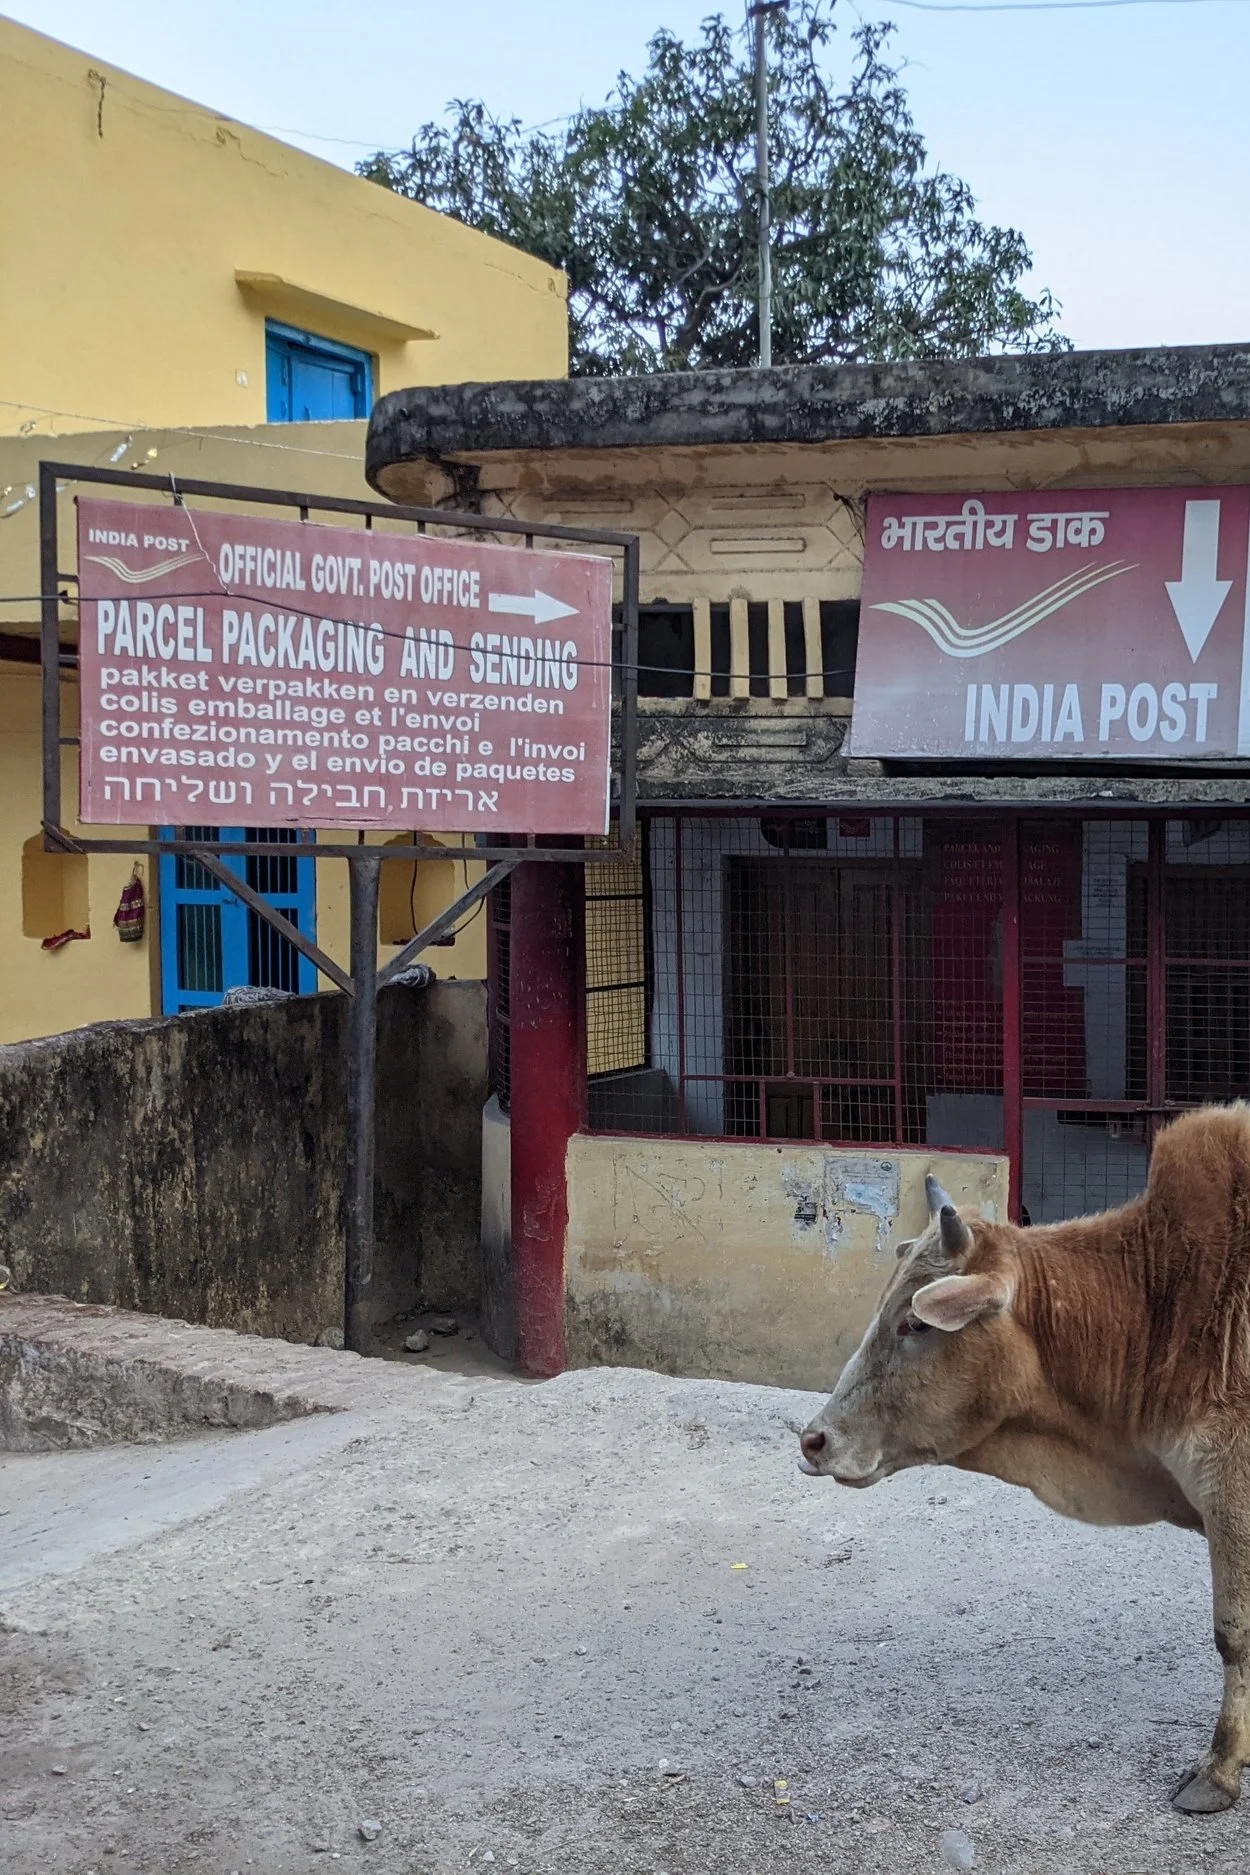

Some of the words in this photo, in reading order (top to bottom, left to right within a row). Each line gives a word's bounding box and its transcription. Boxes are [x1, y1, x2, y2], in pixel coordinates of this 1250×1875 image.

[88, 528, 139, 548] INDIA
[143, 534, 190, 553] POST
[880, 499, 1018, 551] भारतीय
[1025, 511, 1109, 552] डाक
[219, 542, 307, 592] OFFICIAL
[310, 553, 364, 598] GOVT.
[369, 559, 417, 602] POST
[420, 565, 481, 609] OFFICE
[97, 599, 213, 664] PARCEL
[222, 608, 385, 677] PACKAGING
[399, 625, 455, 681] AND
[469, 631, 579, 692] SENDING
[99, 691, 178, 715] colis
[188, 697, 346, 729] emballage
[354, 706, 382, 727] et
[391, 707, 480, 732] l'envoi
[100, 665, 209, 690] pakket
[218, 675, 375, 702] verpakken
[383, 687, 418, 706] en
[426, 690, 564, 716] verzenden
[964, 682, 1084, 743] INDIA
[1099, 681, 1218, 743] POST
[99, 718, 370, 749] confezionamento
[378, 733, 470, 756] pacchi
[478, 740, 494, 756] e
[509, 737, 586, 762] l'invoi
[99, 745, 256, 769] envasado
[264, 753, 283, 775] y
[291, 750, 318, 771] el
[327, 754, 406, 776] envio
[413, 756, 448, 777] de
[456, 761, 576, 784] paquetes
[103, 774, 253, 804] ושליחה
[269, 780, 387, 809] חבילה
[400, 786, 499, 813] אריזת
